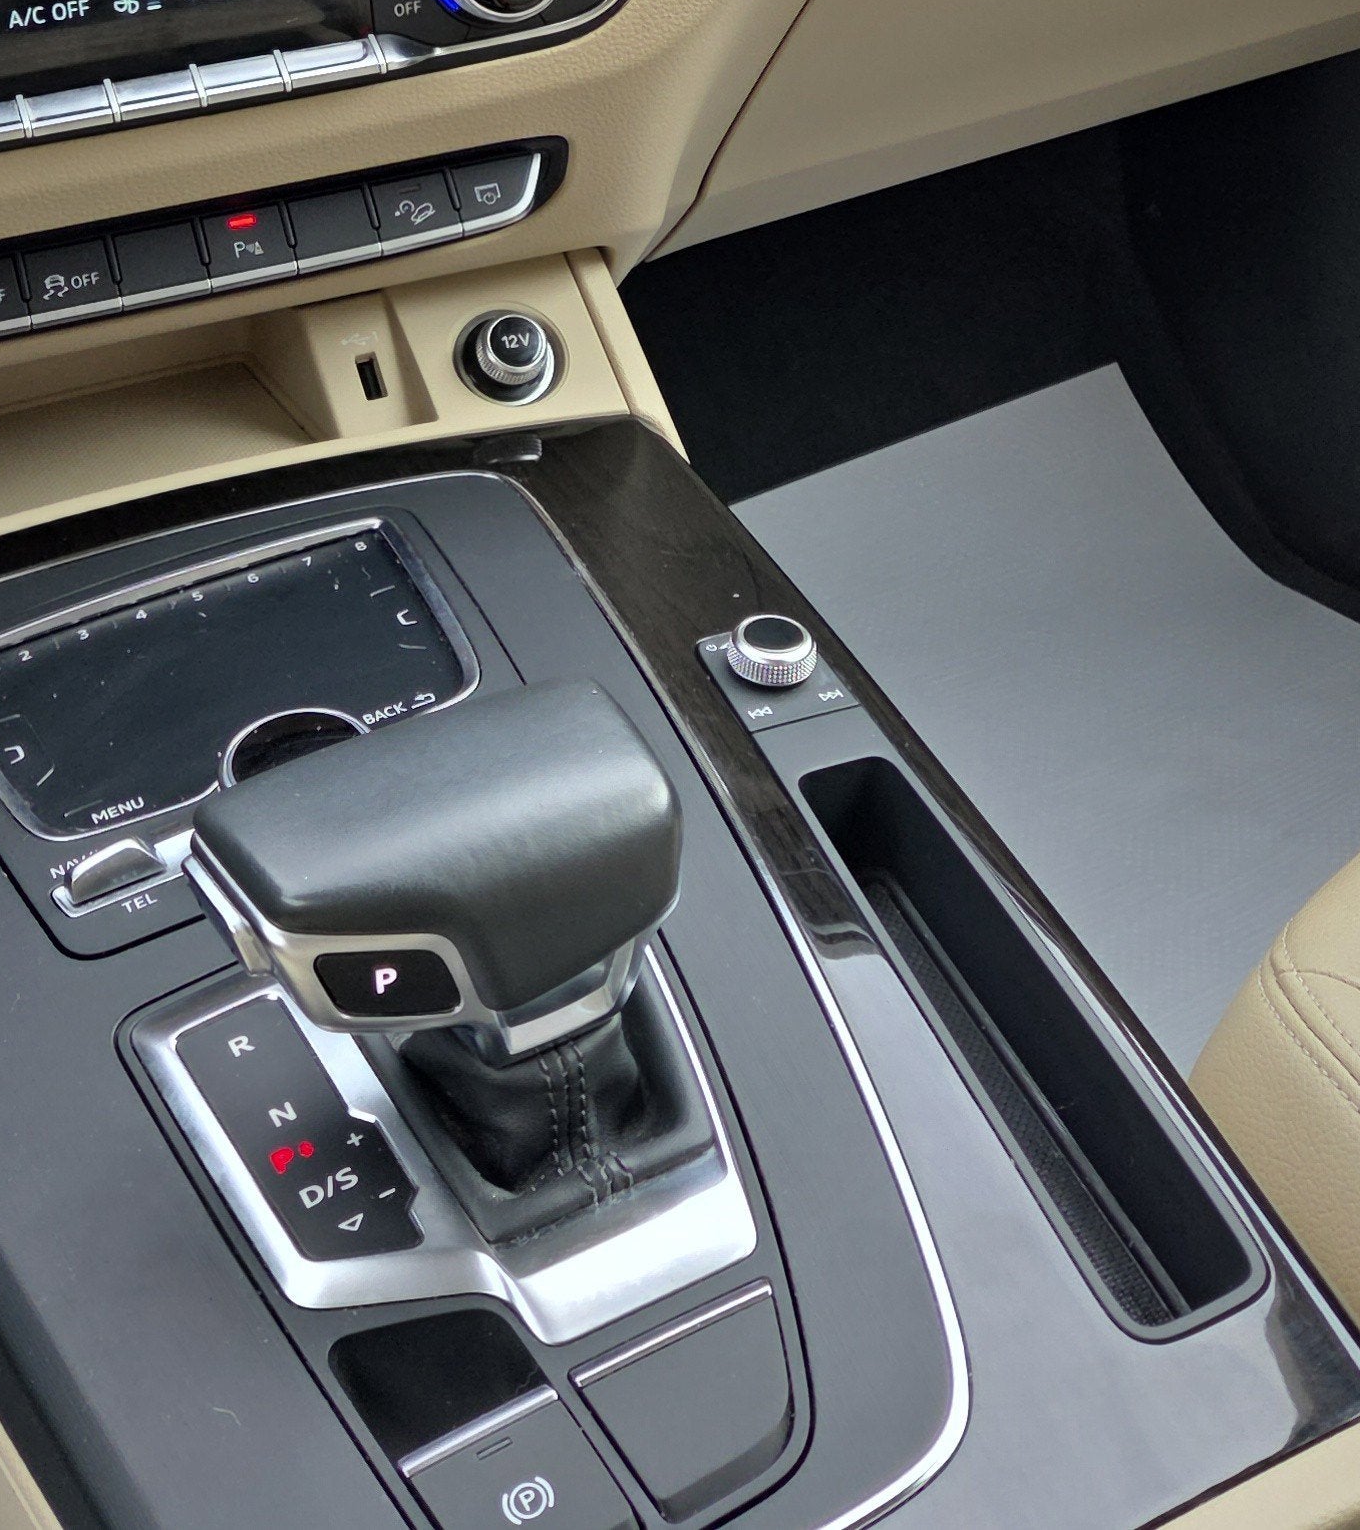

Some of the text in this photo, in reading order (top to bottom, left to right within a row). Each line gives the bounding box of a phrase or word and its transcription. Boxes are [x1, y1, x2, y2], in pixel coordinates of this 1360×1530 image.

[8, 0, 90, 29] A/C OFF
[394, 0, 422, 17] OFF
[71, 272, 100, 290] OFF
[501, 332, 530, 349] 12V
[18, 650, 33, 661] 2
[77, 629, 89, 640] 3
[136, 609, 148, 619] 4
[192, 591, 204, 602] 5
[247, 573, 259, 583] 6
[301, 556, 312, 567] 7
[355, 541, 368, 552] 8
[362, 701, 408, 725] BACK
[90, 796, 145, 824] MENU
[121, 893, 158, 913] TEL
[374, 968, 398, 994] P
[228, 1035, 255, 1058] R
[268, 1101, 297, 1128] N
[299, 1166, 359, 1209] D/S
